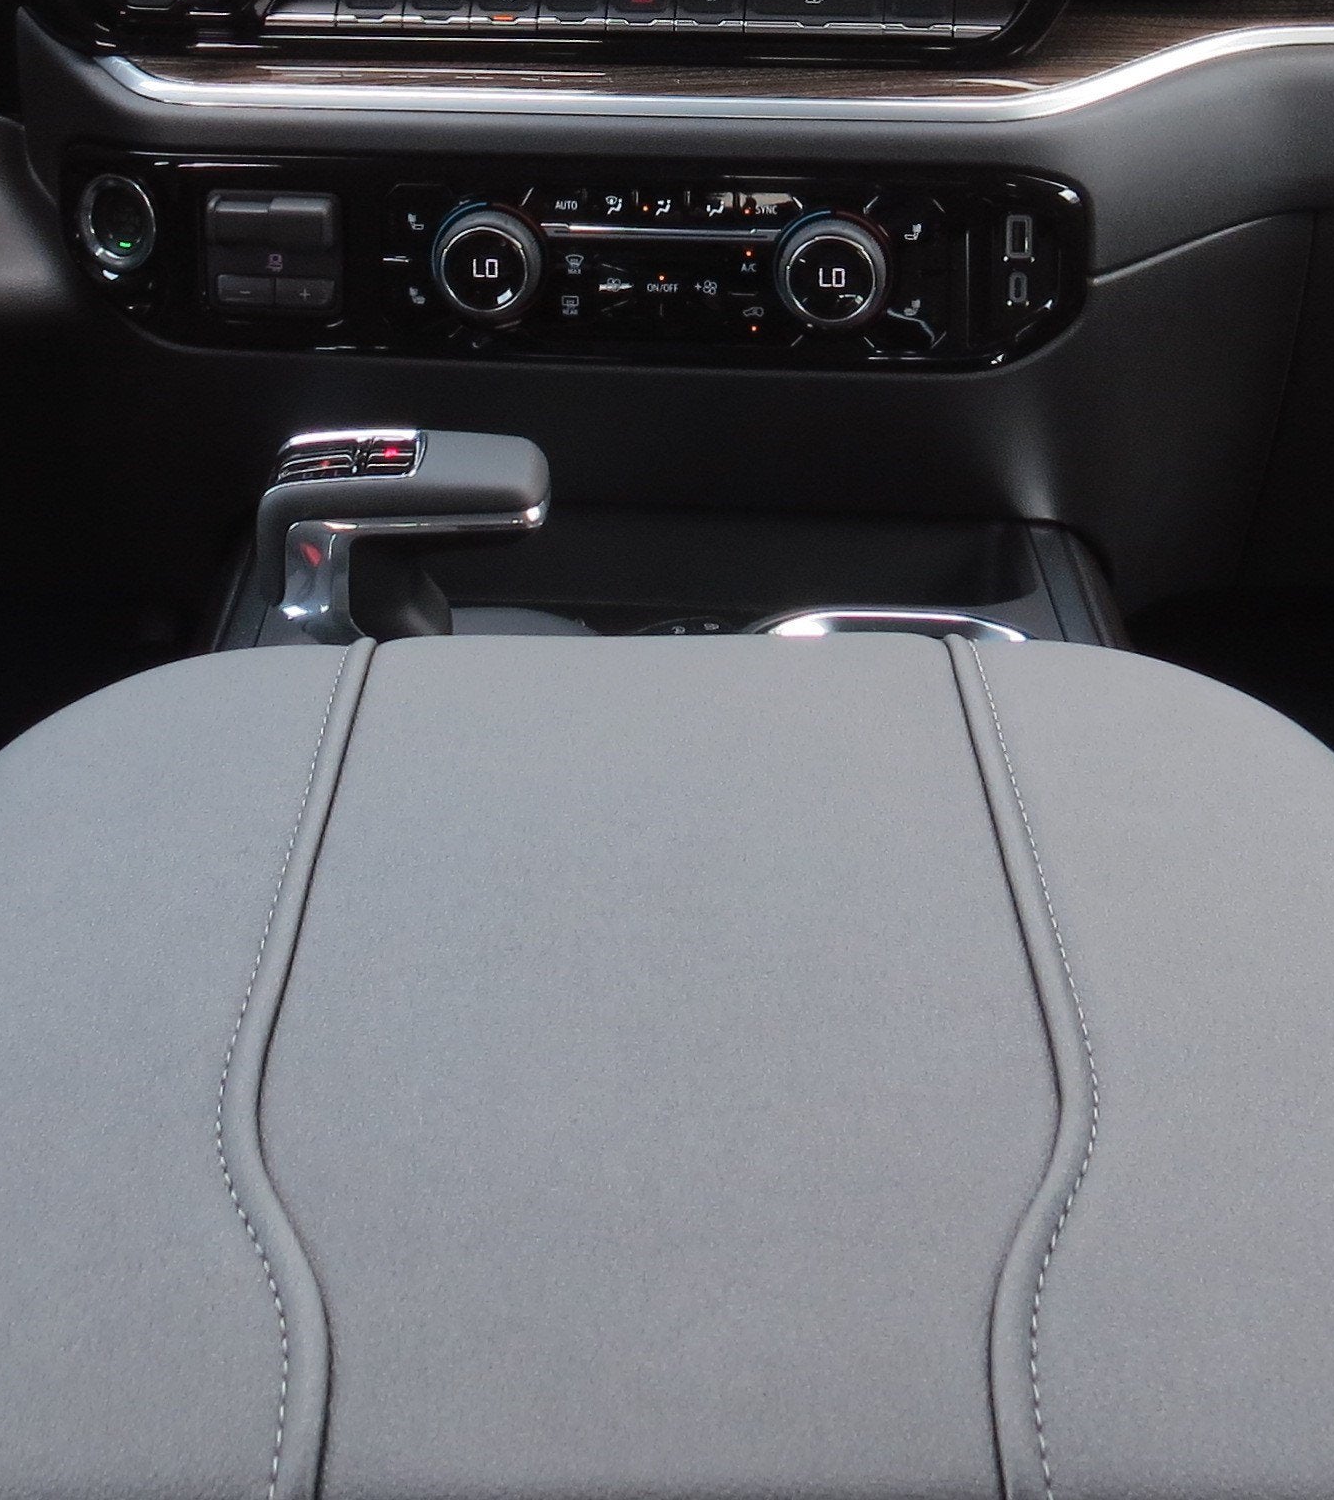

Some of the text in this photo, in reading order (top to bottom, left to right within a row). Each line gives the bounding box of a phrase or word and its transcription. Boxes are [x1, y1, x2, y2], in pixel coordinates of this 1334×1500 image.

[555, 200, 578, 210] AUTO
[755, 205, 778, 215] SYNC
[472, 258, 499, 278] LO
[740, 263, 756, 273] A/C
[819, 267, 846, 288] LO
[646, 283, 679, 292] ON/OFF
